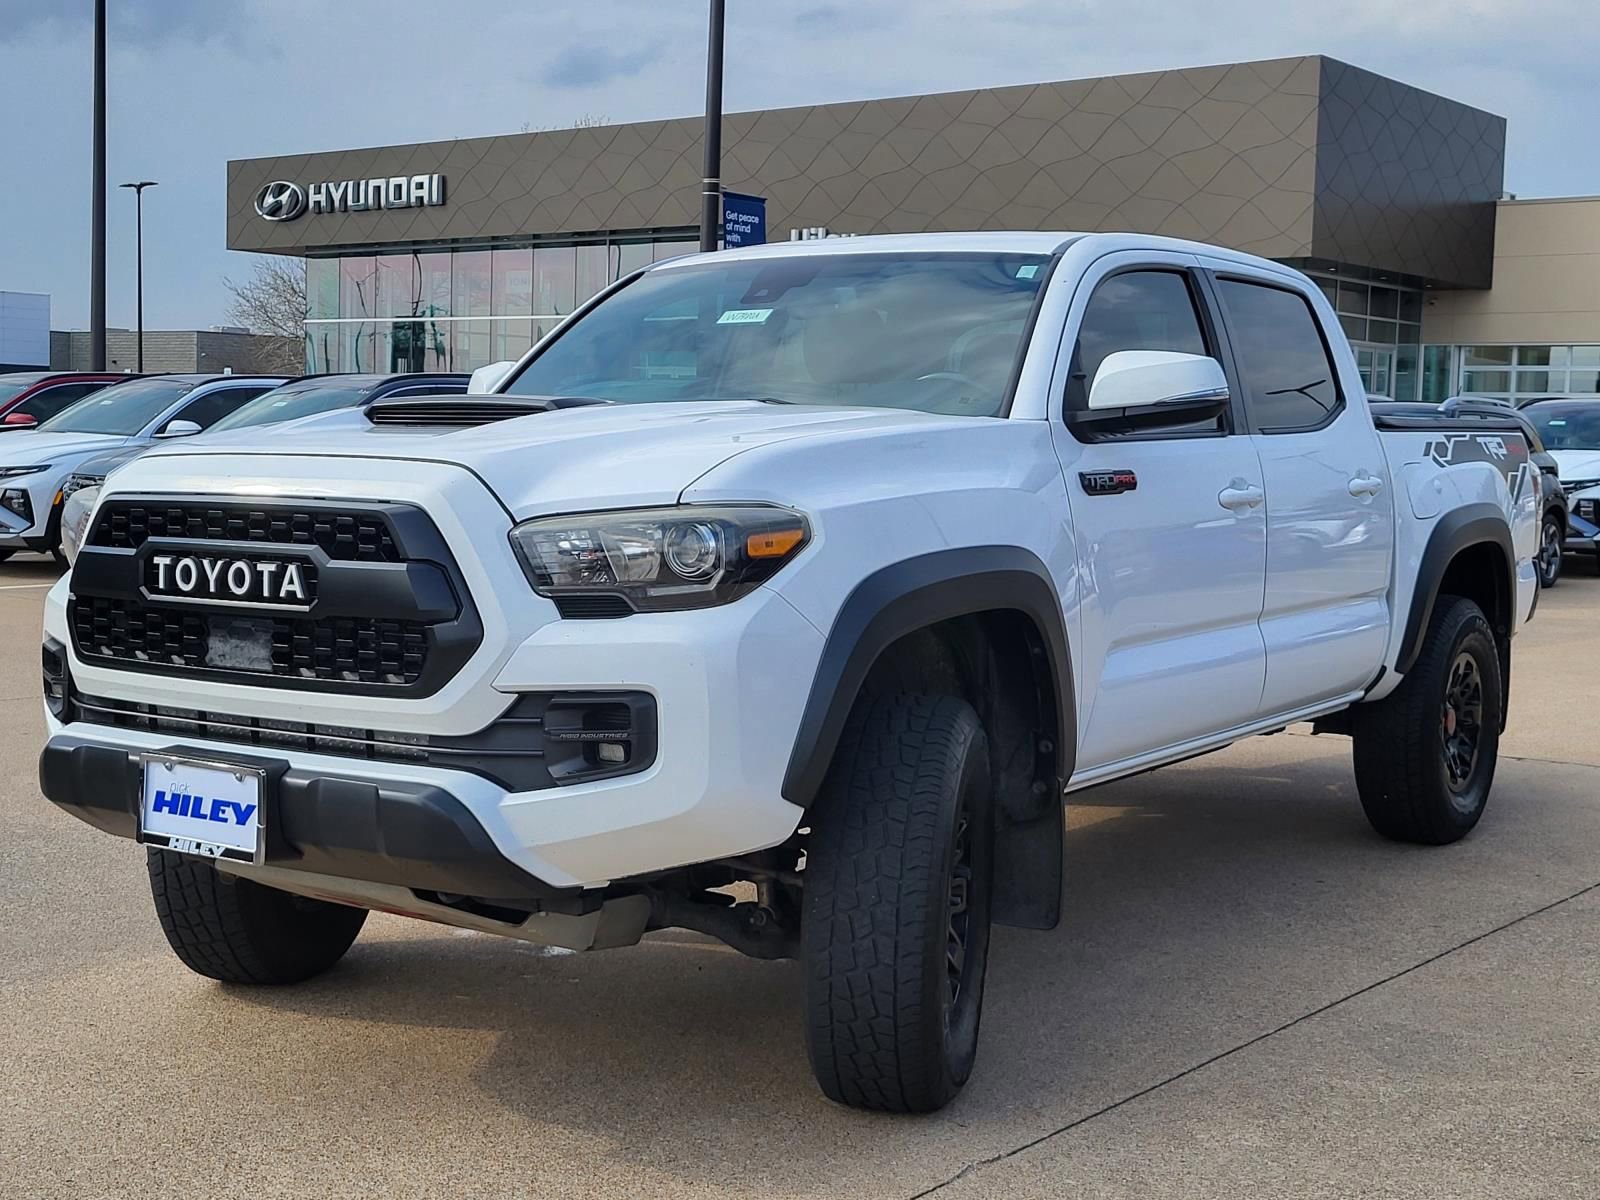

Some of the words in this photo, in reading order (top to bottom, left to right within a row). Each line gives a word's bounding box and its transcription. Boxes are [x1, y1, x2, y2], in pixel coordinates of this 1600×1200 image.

[308, 173, 446, 213] HYUNDAI
[725, 210, 738, 221] Get
[739, 213, 760, 225] peace
[725, 222, 734, 231] of
[734, 222, 751, 233] mind
[725, 232, 742, 243] with
[153, 556, 304, 599] TOYOTA
[152, 790, 256, 826] HILEY
[168, 837, 226, 858] HILEY
